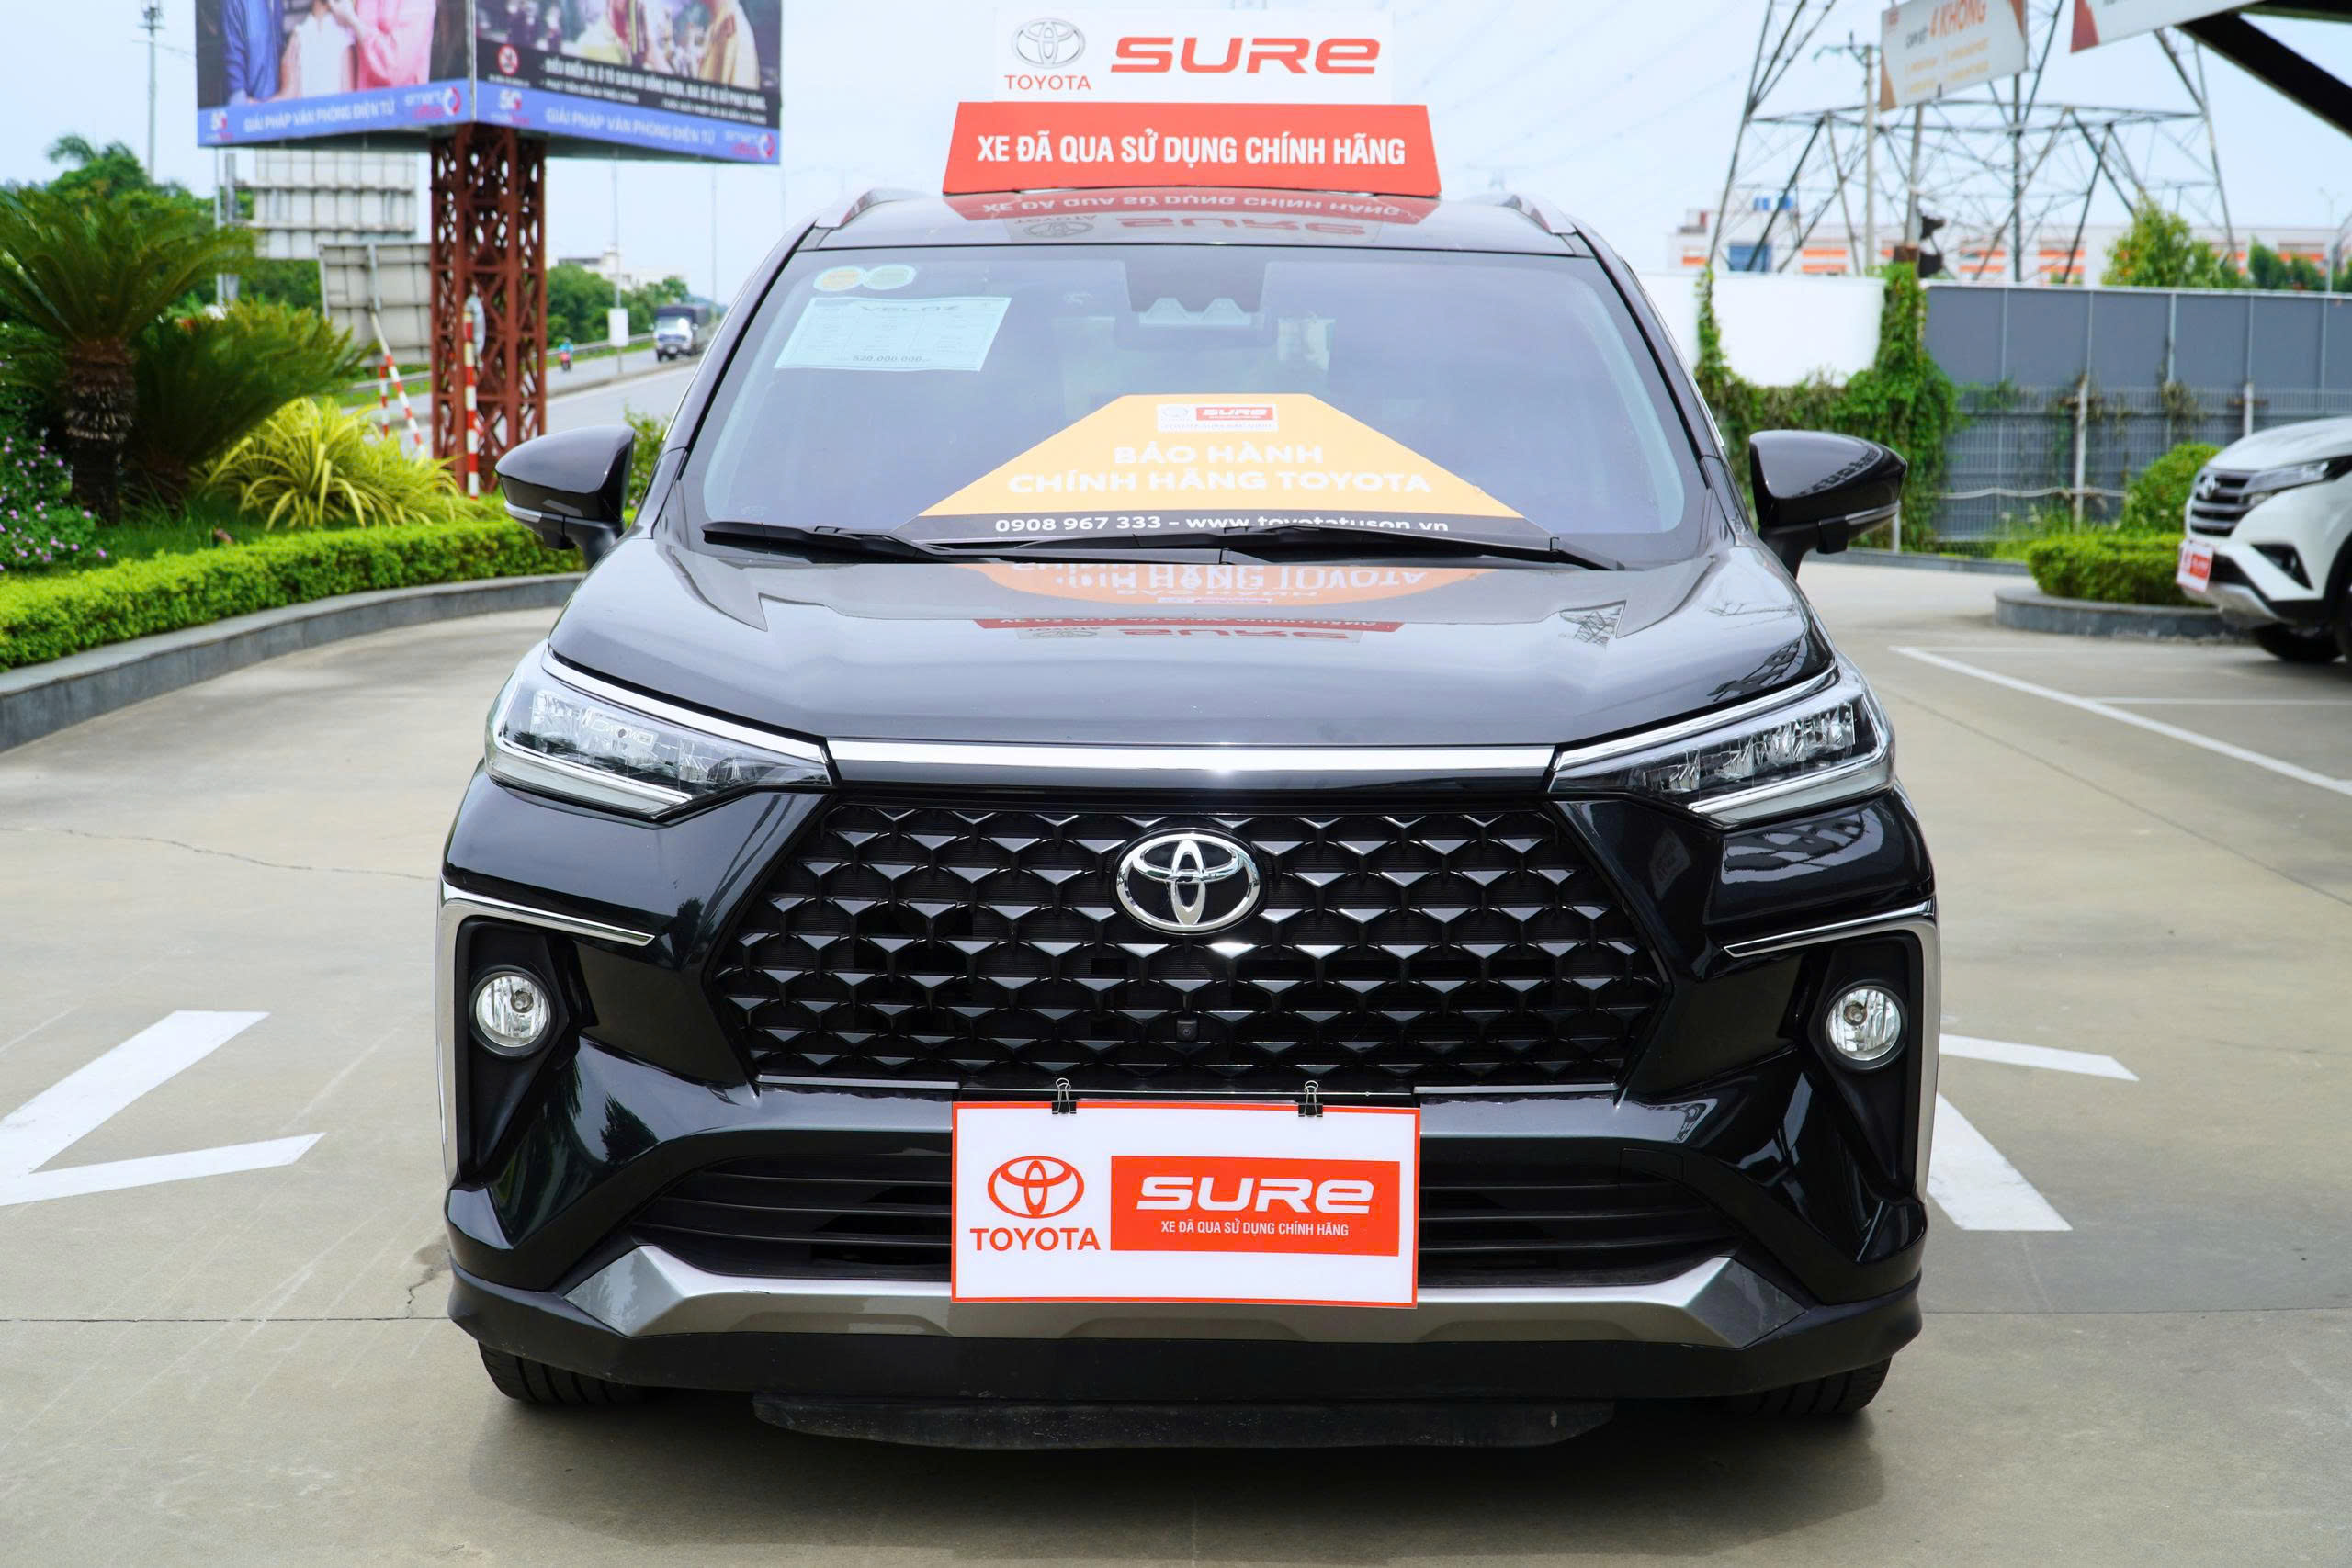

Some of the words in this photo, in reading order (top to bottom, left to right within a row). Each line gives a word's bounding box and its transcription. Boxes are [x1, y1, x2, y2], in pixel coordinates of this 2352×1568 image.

[1004, 74, 1091, 91] TOYOTA
[977, 135, 1010, 162] XE
[1016, 130, 1053, 162] ĐÃ
[1059, 135, 1114, 164] QUA
[1120, 127, 1159, 163] SỬ
[1164, 135, 1237, 169] DỤNG
[1245, 131, 1326, 164] CHÍNH
[1333, 132, 1405, 165] HÃNG
[1114, 441, 1197, 463] BẢO
[1207, 441, 1324, 463] HÀNH
[1007, 469, 1137, 493] CHÍNH
[1148, 467, 1267, 491] HÃNG
[1276, 470, 1431, 493] TOYOTA
[995, 518, 1057, 533] 0908
[1063, 516, 1109, 531] 967
[1116, 515, 1161, 529] 333
[969, 1227, 1101, 1251] TOYOTA
[1161, 1221, 1175, 1233] XE
[1179, 1219, 1194, 1233] ĐÃ
[1197, 1221, 1221, 1234] QUA
[1224, 1218, 1241, 1235] SỬ
[1243, 1222, 1275, 1238] DỤNG
[1279, 1221, 1314, 1235] CHÍNH
[1317, 1221, 1349, 1236] HÃNG
